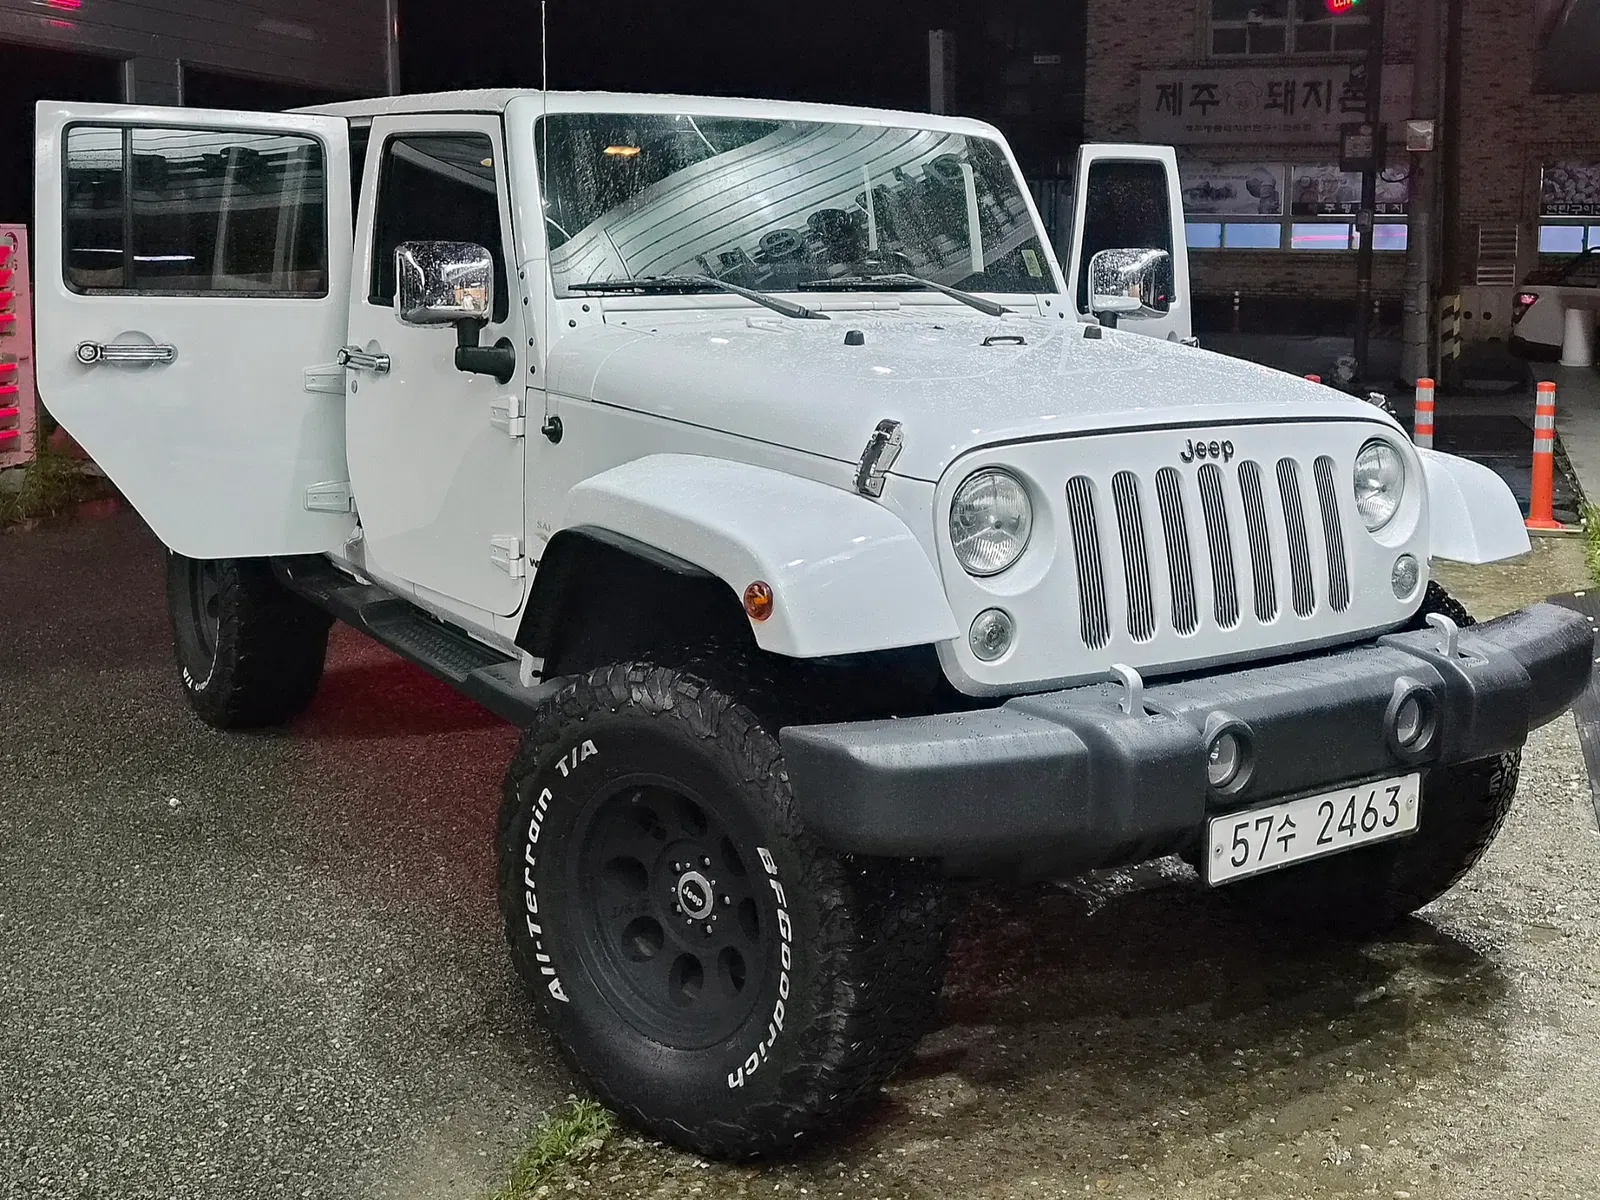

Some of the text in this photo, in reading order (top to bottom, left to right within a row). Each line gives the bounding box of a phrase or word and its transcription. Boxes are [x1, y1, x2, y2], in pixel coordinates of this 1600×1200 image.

[1155, 82, 1220, 117] 제주
[1180, 438, 1234, 463] Jeep
[1231, 785, 1401, 868] 57수 2463
[524, 739, 599, 1003] All-Terrain T/A
[682, 886, 703, 907] Jeep
[728, 846, 793, 1089] BFGoodrich
